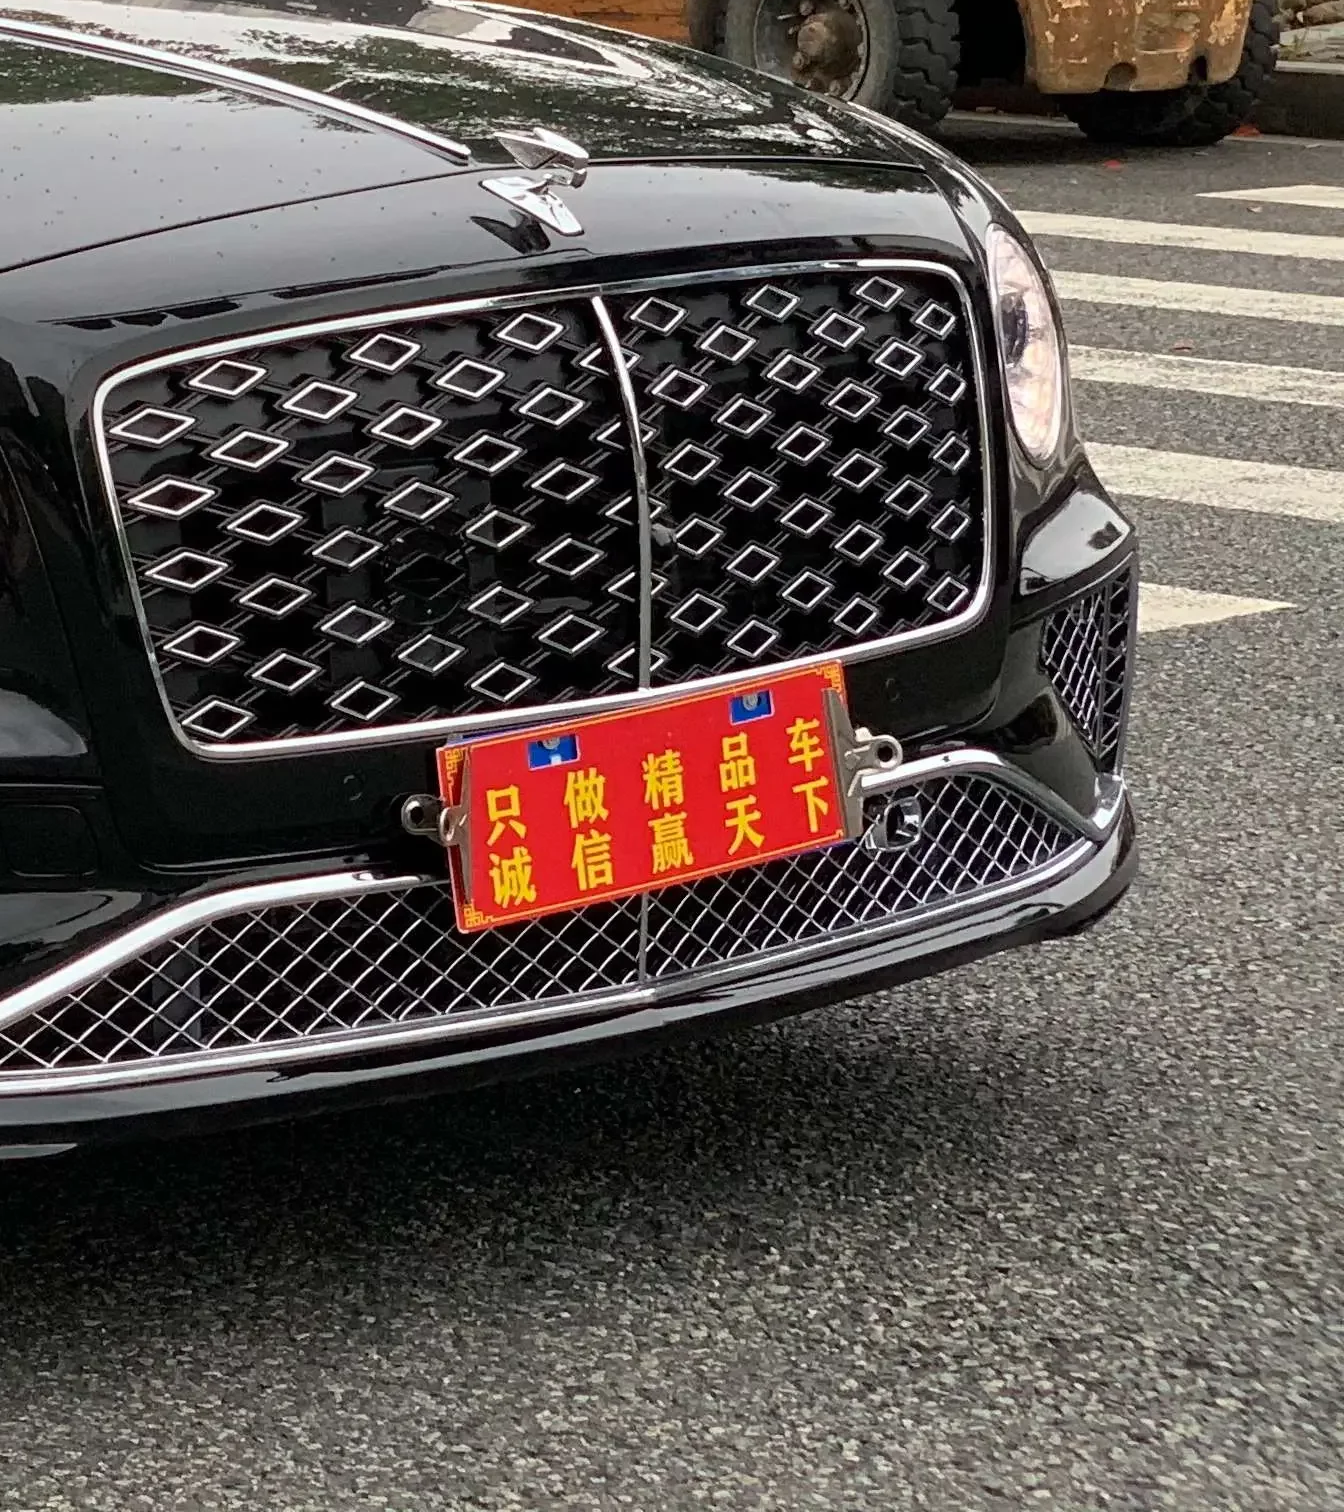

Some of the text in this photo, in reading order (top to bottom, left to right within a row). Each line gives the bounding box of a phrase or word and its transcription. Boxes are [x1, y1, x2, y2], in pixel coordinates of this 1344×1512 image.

[485, 716, 825, 846] 只做精品车
[489, 776, 830, 910] 诚信赢天下
